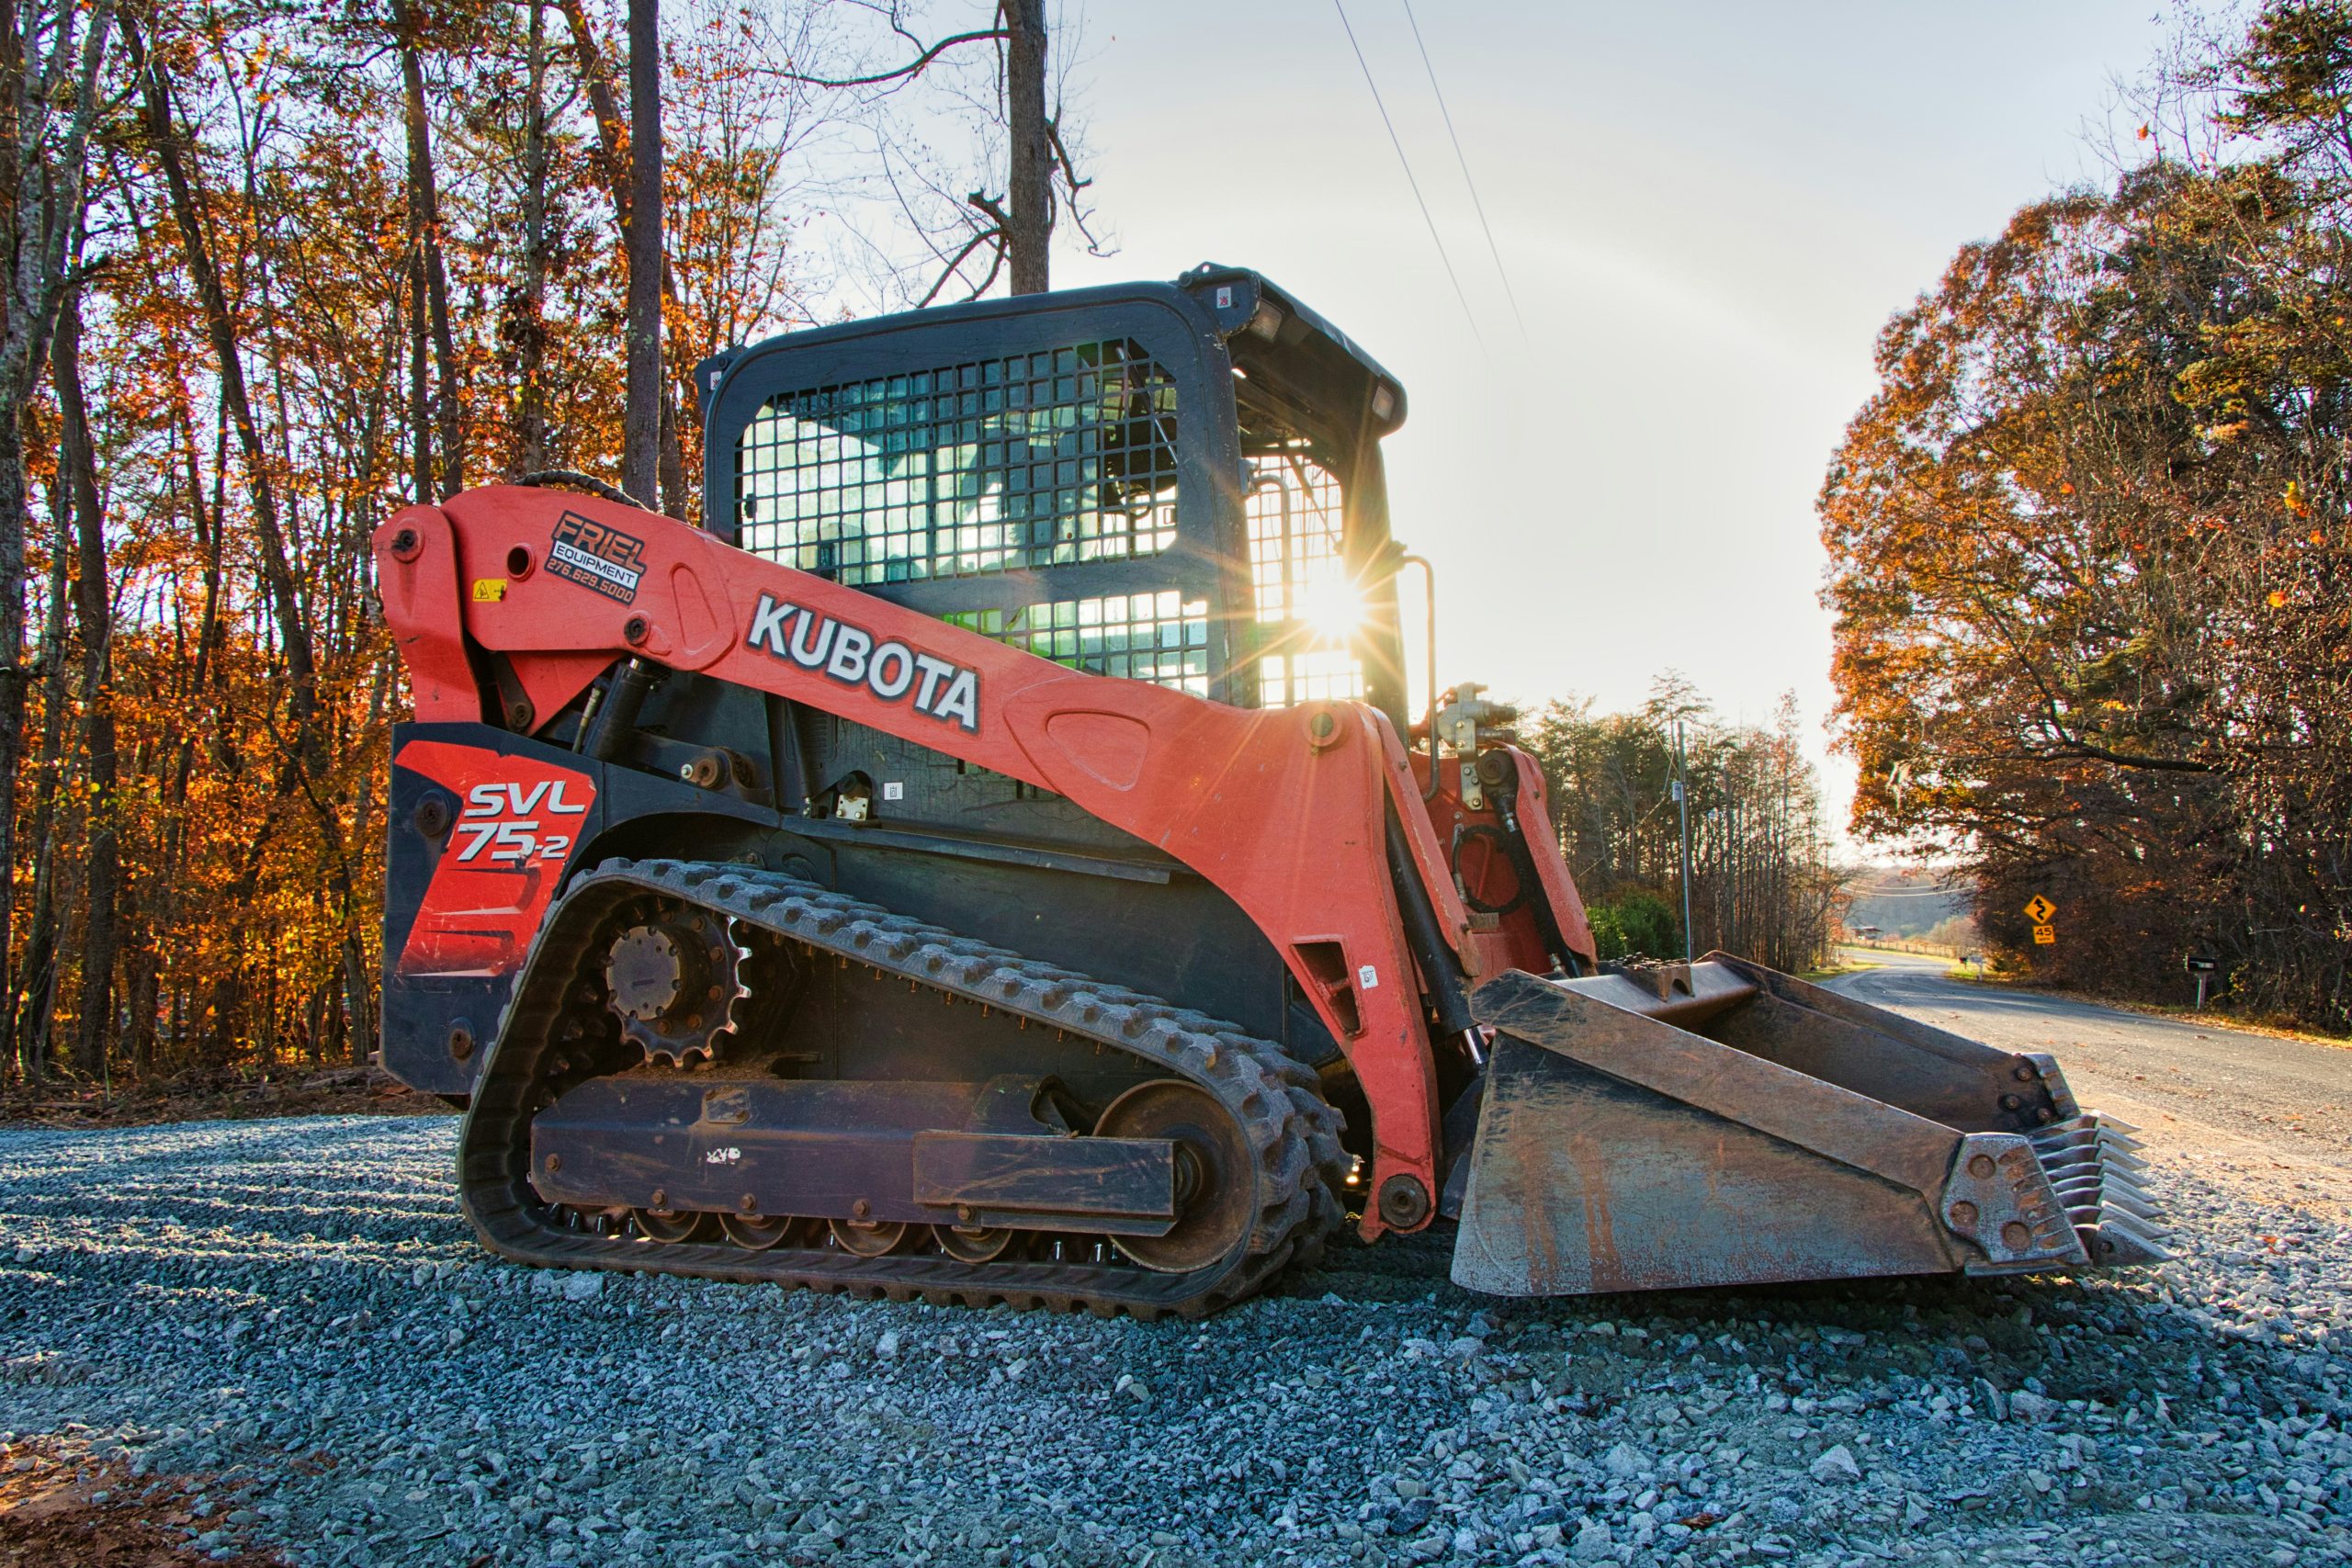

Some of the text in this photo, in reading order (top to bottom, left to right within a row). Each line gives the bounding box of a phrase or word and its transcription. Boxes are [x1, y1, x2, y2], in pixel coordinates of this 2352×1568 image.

[554, 514, 645, 573] FRIEL
[547, 558, 634, 603] 276.629.5000
[556, 545, 635, 584] EQUIPMENT
[748, 594, 977, 728] KUBOTA
[464, 781, 585, 817] SVL
[457, 821, 570, 862] 75-2
[2036, 928, 2052, 936] 45
